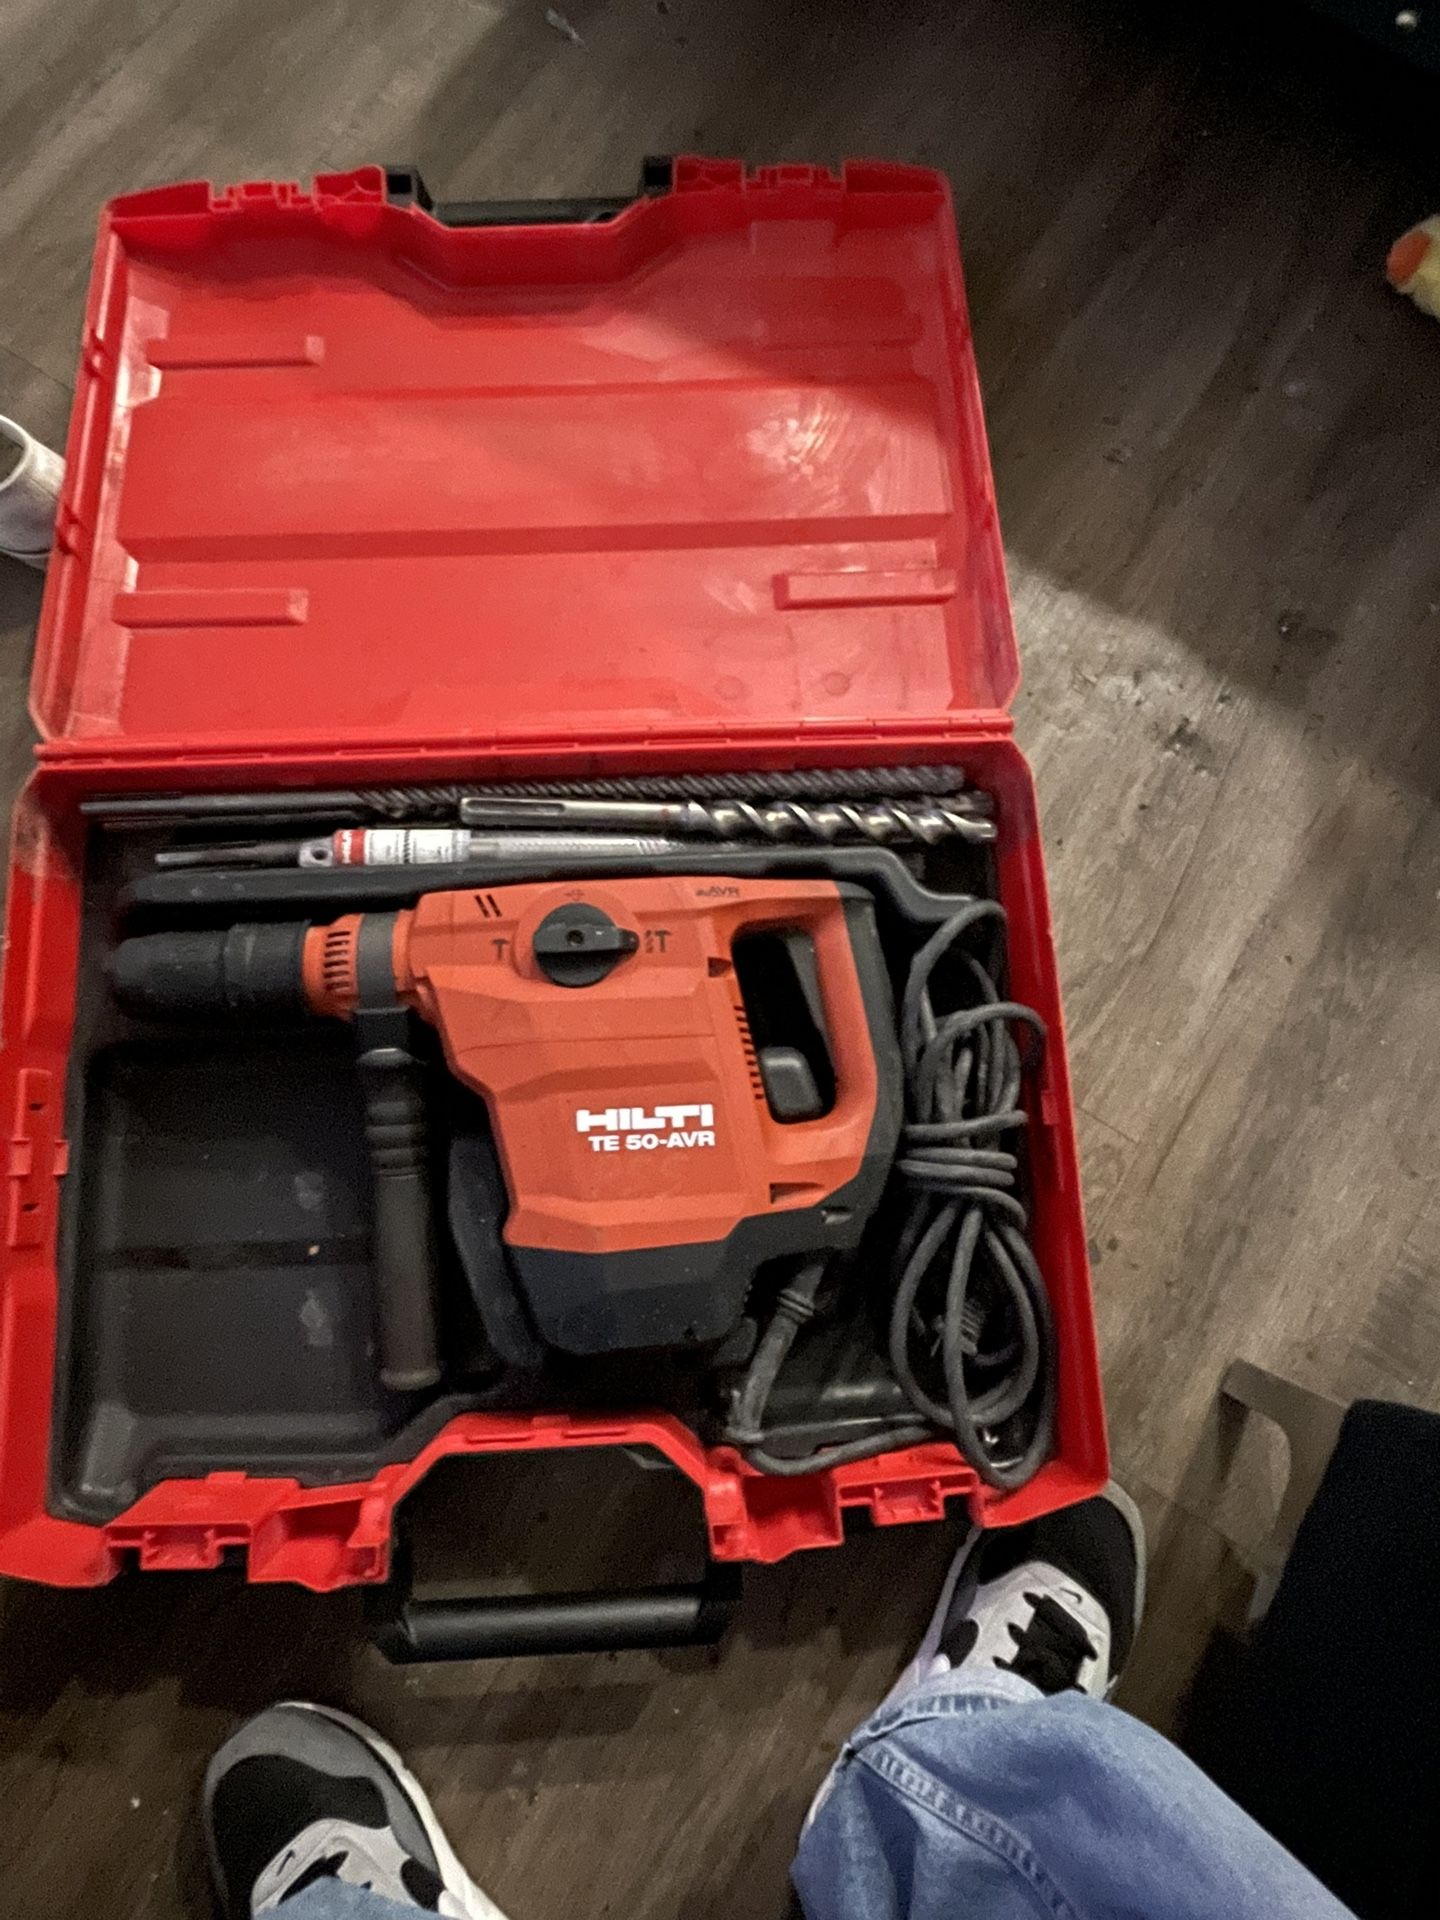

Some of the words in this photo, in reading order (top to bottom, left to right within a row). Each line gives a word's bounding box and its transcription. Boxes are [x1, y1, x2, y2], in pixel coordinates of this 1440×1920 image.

[576, 1103, 714, 1132] HILTI
[588, 1135, 620, 1152] TE
[624, 1131, 716, 1151] 50-AVR
